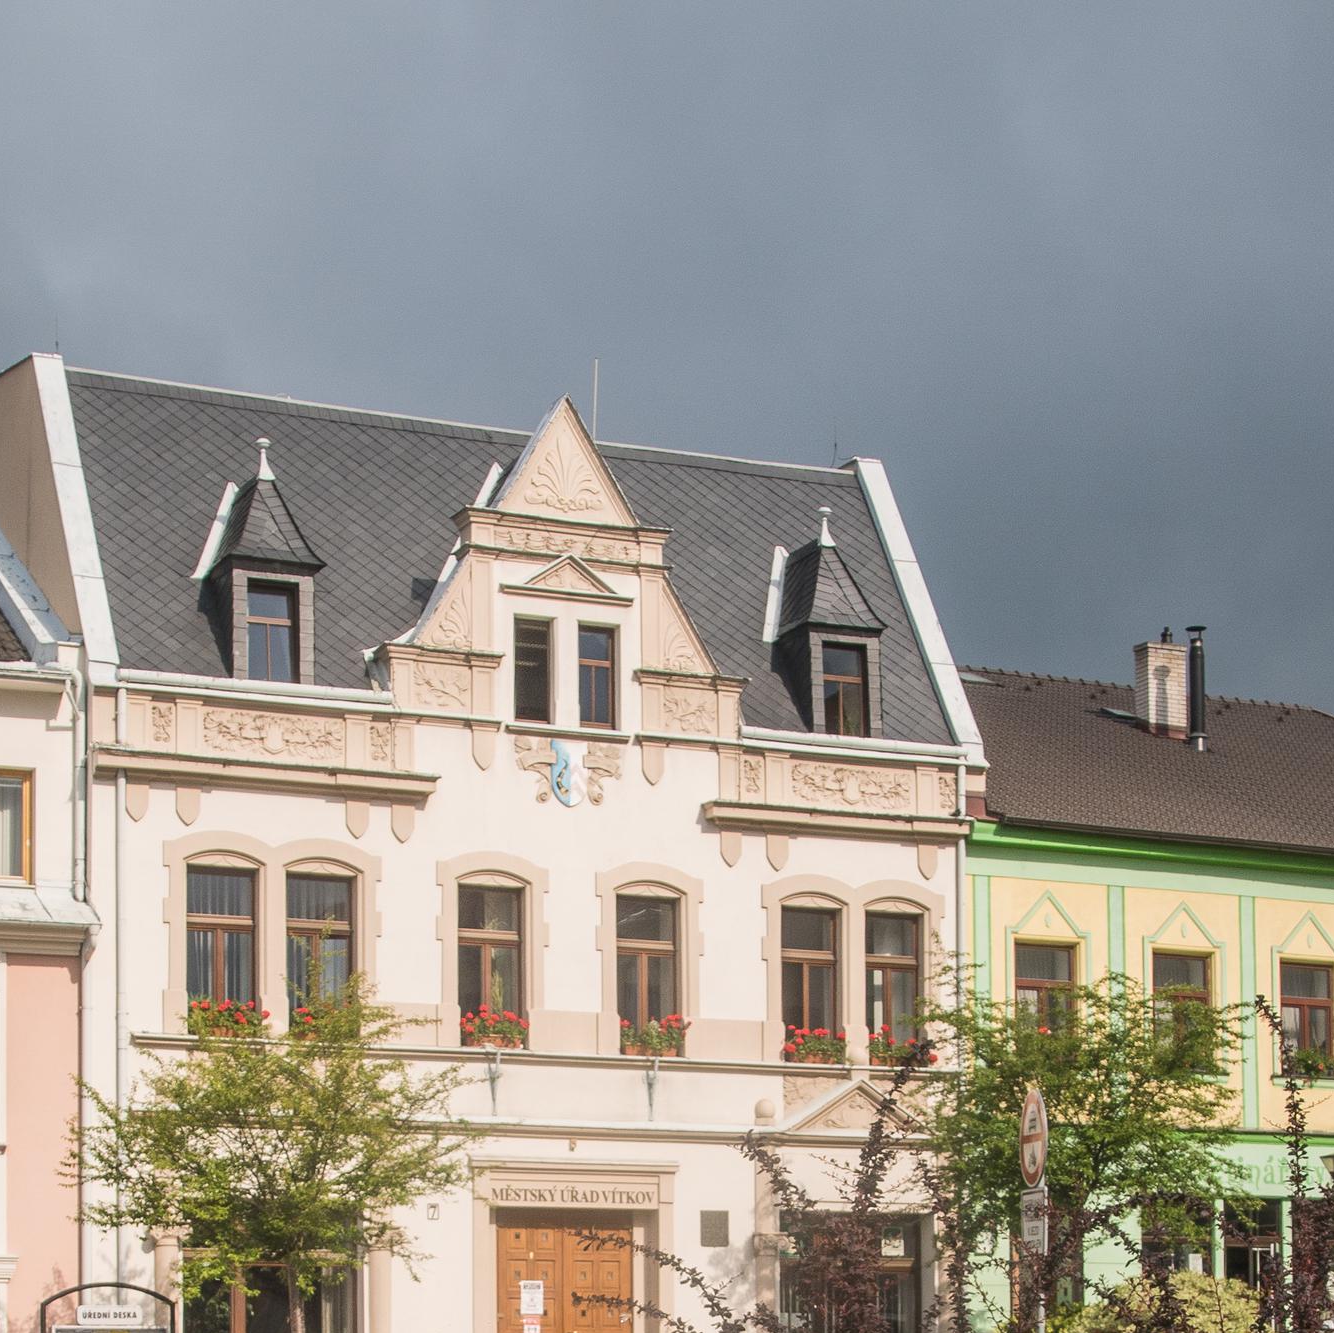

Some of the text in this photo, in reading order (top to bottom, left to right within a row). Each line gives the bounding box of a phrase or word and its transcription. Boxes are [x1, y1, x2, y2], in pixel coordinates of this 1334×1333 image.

[491, 1185, 655, 1204] MĚSTSKÝ ÚŘAD VÍTKOV
[429, 1204, 437, 1218] 7
[81, 1309, 137, 1319] ÚŘEDNÍ DESKA
